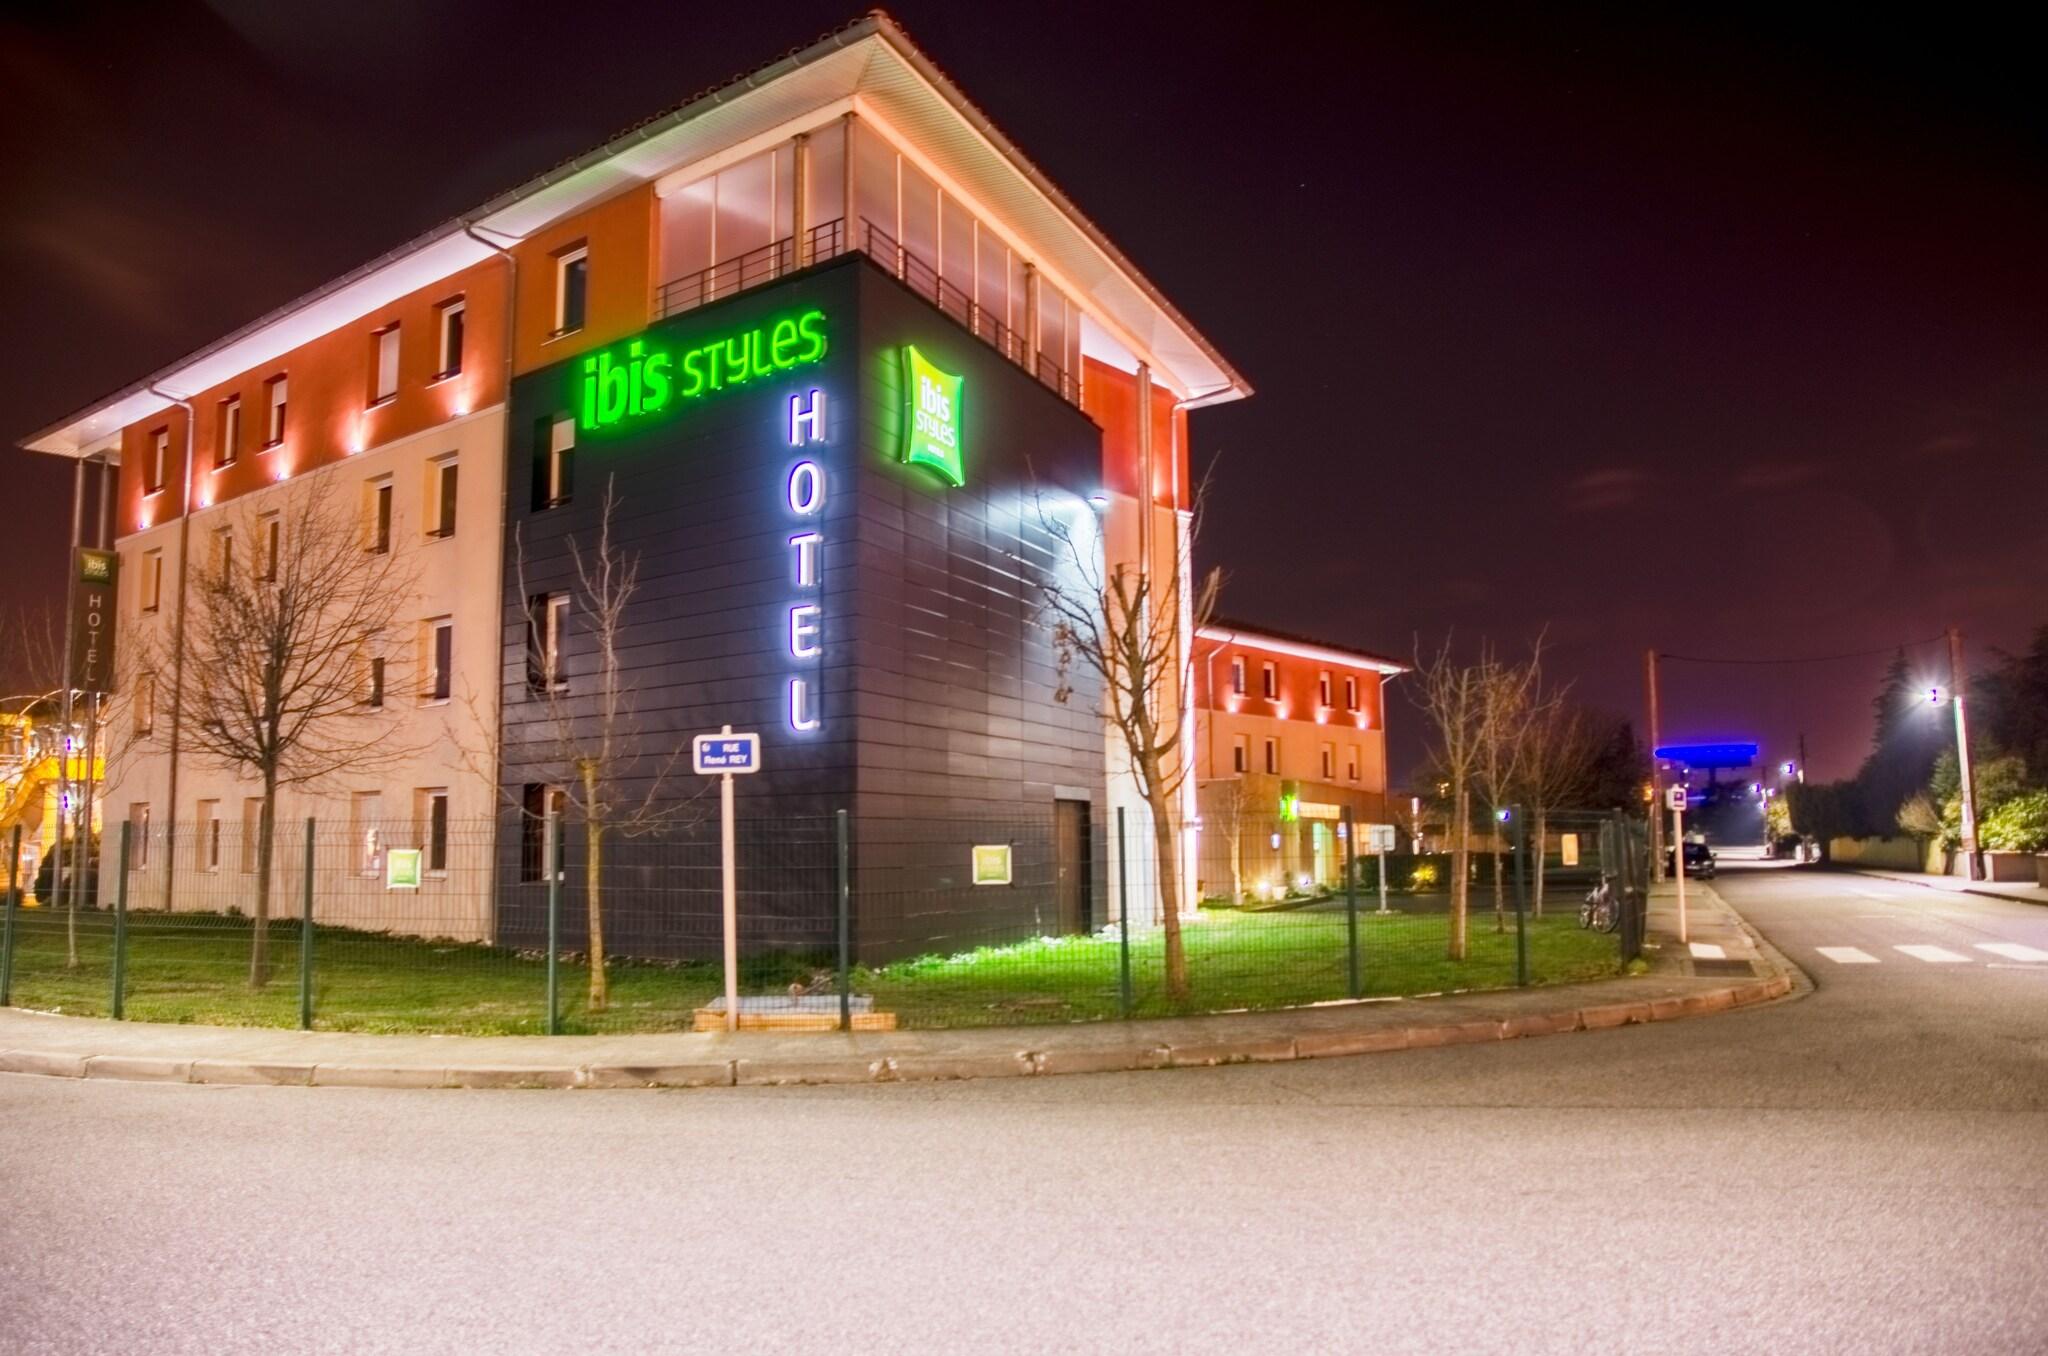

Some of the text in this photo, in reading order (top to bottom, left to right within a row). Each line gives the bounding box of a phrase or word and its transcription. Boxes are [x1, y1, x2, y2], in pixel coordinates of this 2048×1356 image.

[584, 340, 670, 430] ibis
[920, 375, 950, 424] ibis
[87, 559, 107, 571] ibis
[788, 388, 825, 731] HOTEL
[87, 594, 102, 682] HOTEL
[722, 743, 740, 753] RUE
